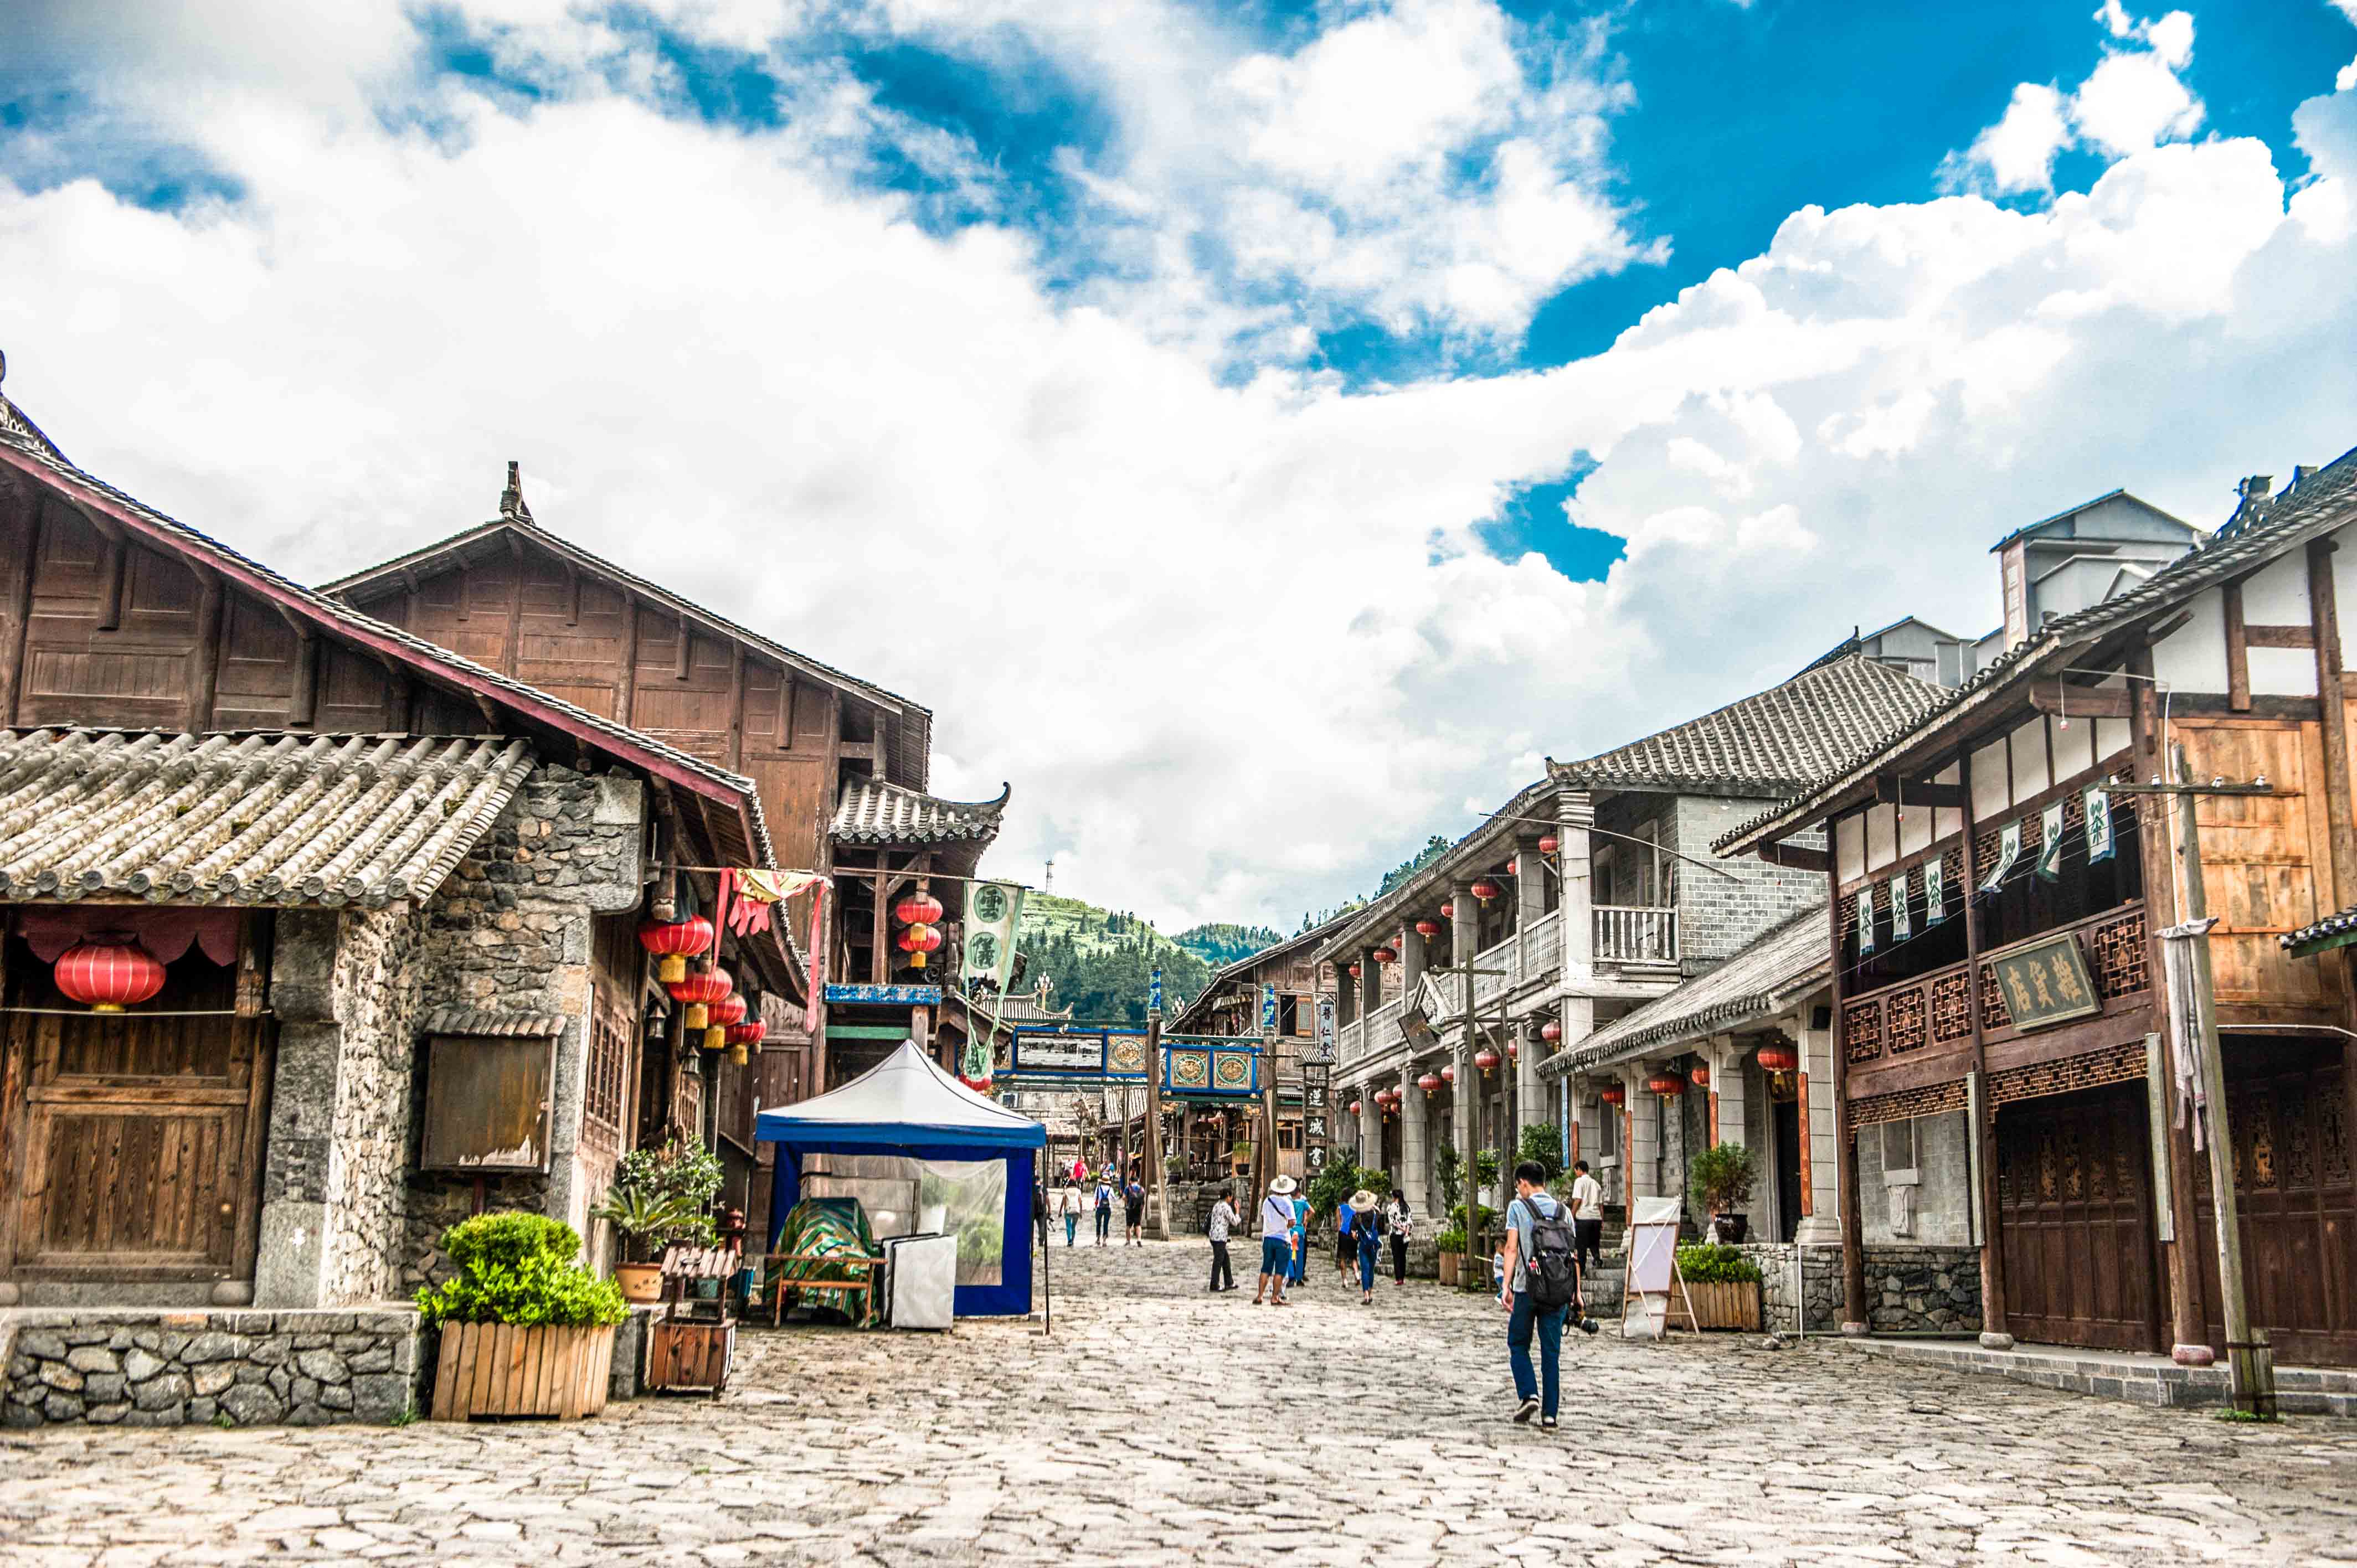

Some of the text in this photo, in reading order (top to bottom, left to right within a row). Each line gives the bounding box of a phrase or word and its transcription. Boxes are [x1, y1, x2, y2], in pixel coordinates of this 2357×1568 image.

[2090, 800, 2104, 845] 茶
[1895, 888, 1907, 926] 茶
[1928, 870, 1941, 909] 茶
[1861, 903, 1872, 938] 茶
[1320, 1006, 1332, 1057] 普仁堂
